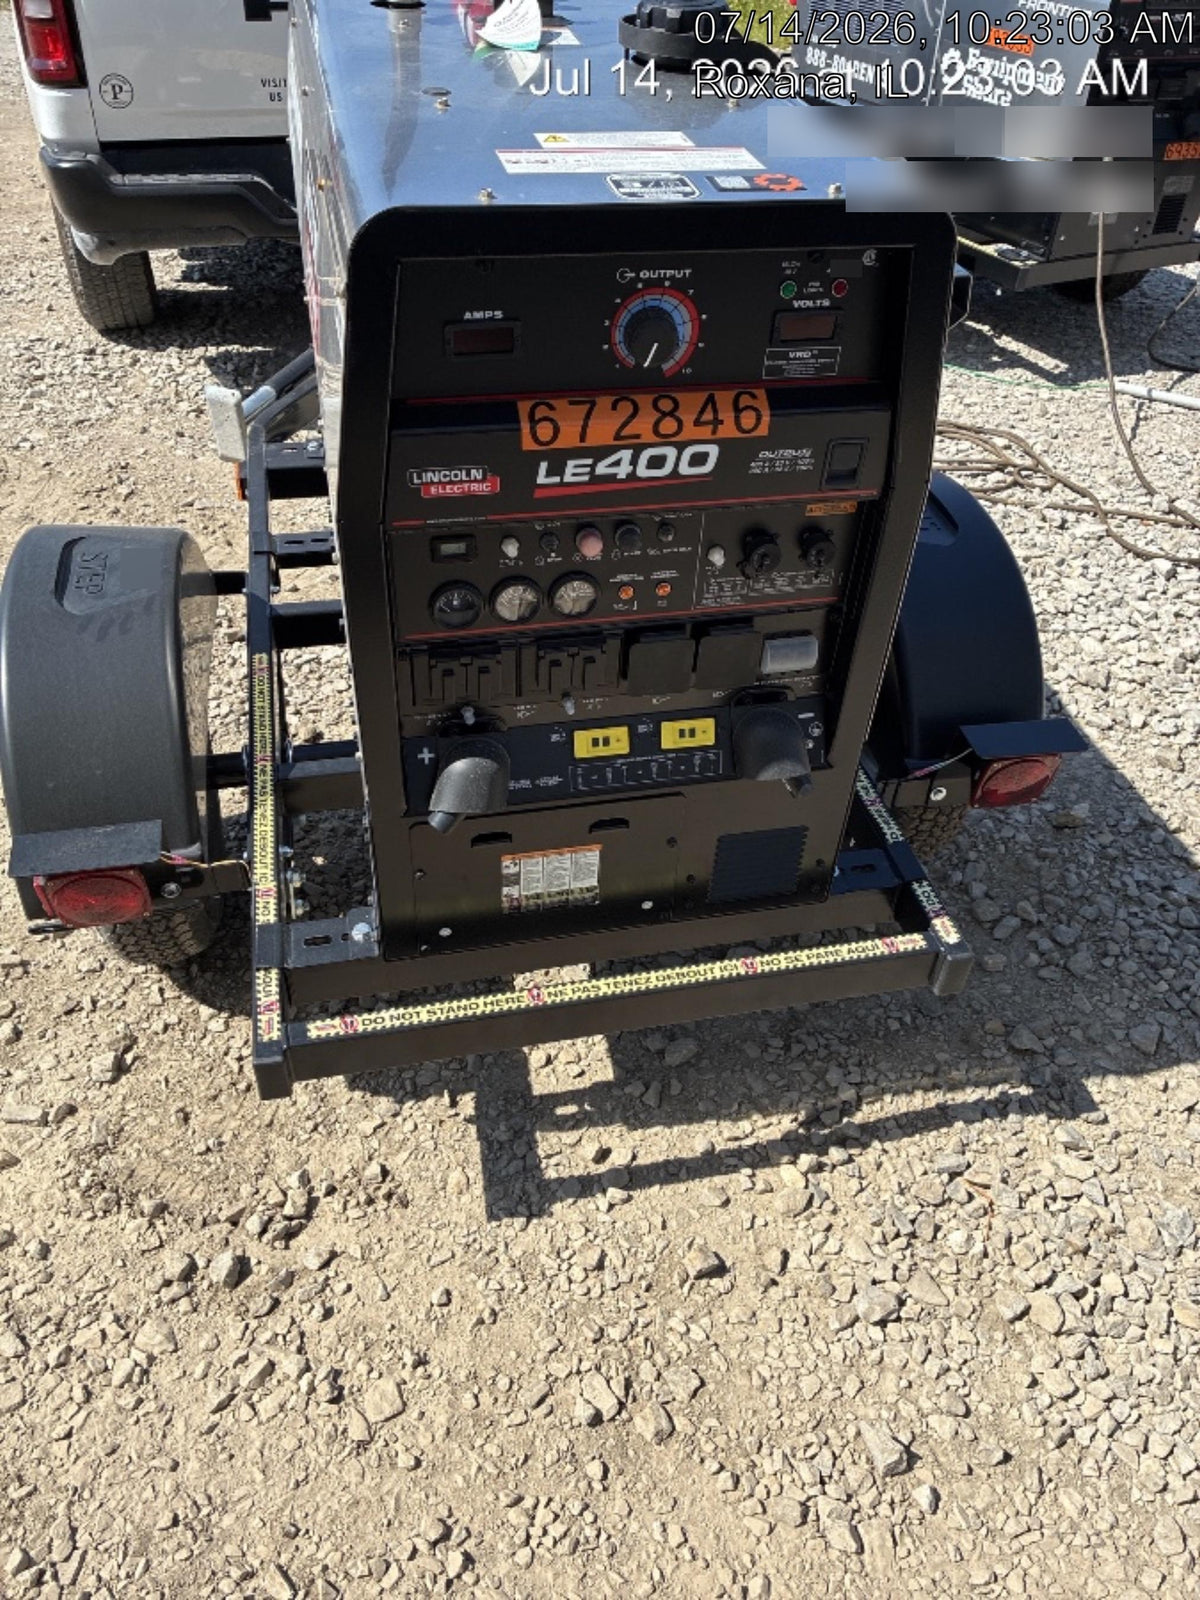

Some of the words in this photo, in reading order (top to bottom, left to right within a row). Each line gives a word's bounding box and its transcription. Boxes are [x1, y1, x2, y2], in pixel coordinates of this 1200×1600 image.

[1018, 0, 1094, 22] FRONTI
[260, 78, 287, 88] VISIT
[111, 83, 123, 100] P
[269, 91, 283, 102] US
[639, 269, 692, 278] OUTPUT
[792, 298, 831, 308] VOLTS
[463, 310, 504, 320] AMPS
[527, 389, 763, 447] 672846
[536, 443, 720, 485] LE400
[413, 468, 483, 484] LINCOLN
[430, 482, 491, 495] ELECTRIC
[760, 956, 782, 968] NO
[785, 953, 804, 965] SE
[806, 949, 845, 962] PARE
[847, 942, 880, 956] AQUI
[546, 986, 569, 1000] NE
[571, 981, 602, 996] PAS
[605, 974, 654, 991] TENEZ
[655, 966, 717, 983] DEBOUT
[719, 962, 740, 974] ICI
[361, 1016, 385, 1028] DO
[390, 1009, 423, 1023] NOT
[426, 1001, 481, 1018] STAND
[482, 994, 526, 1010] HERE
